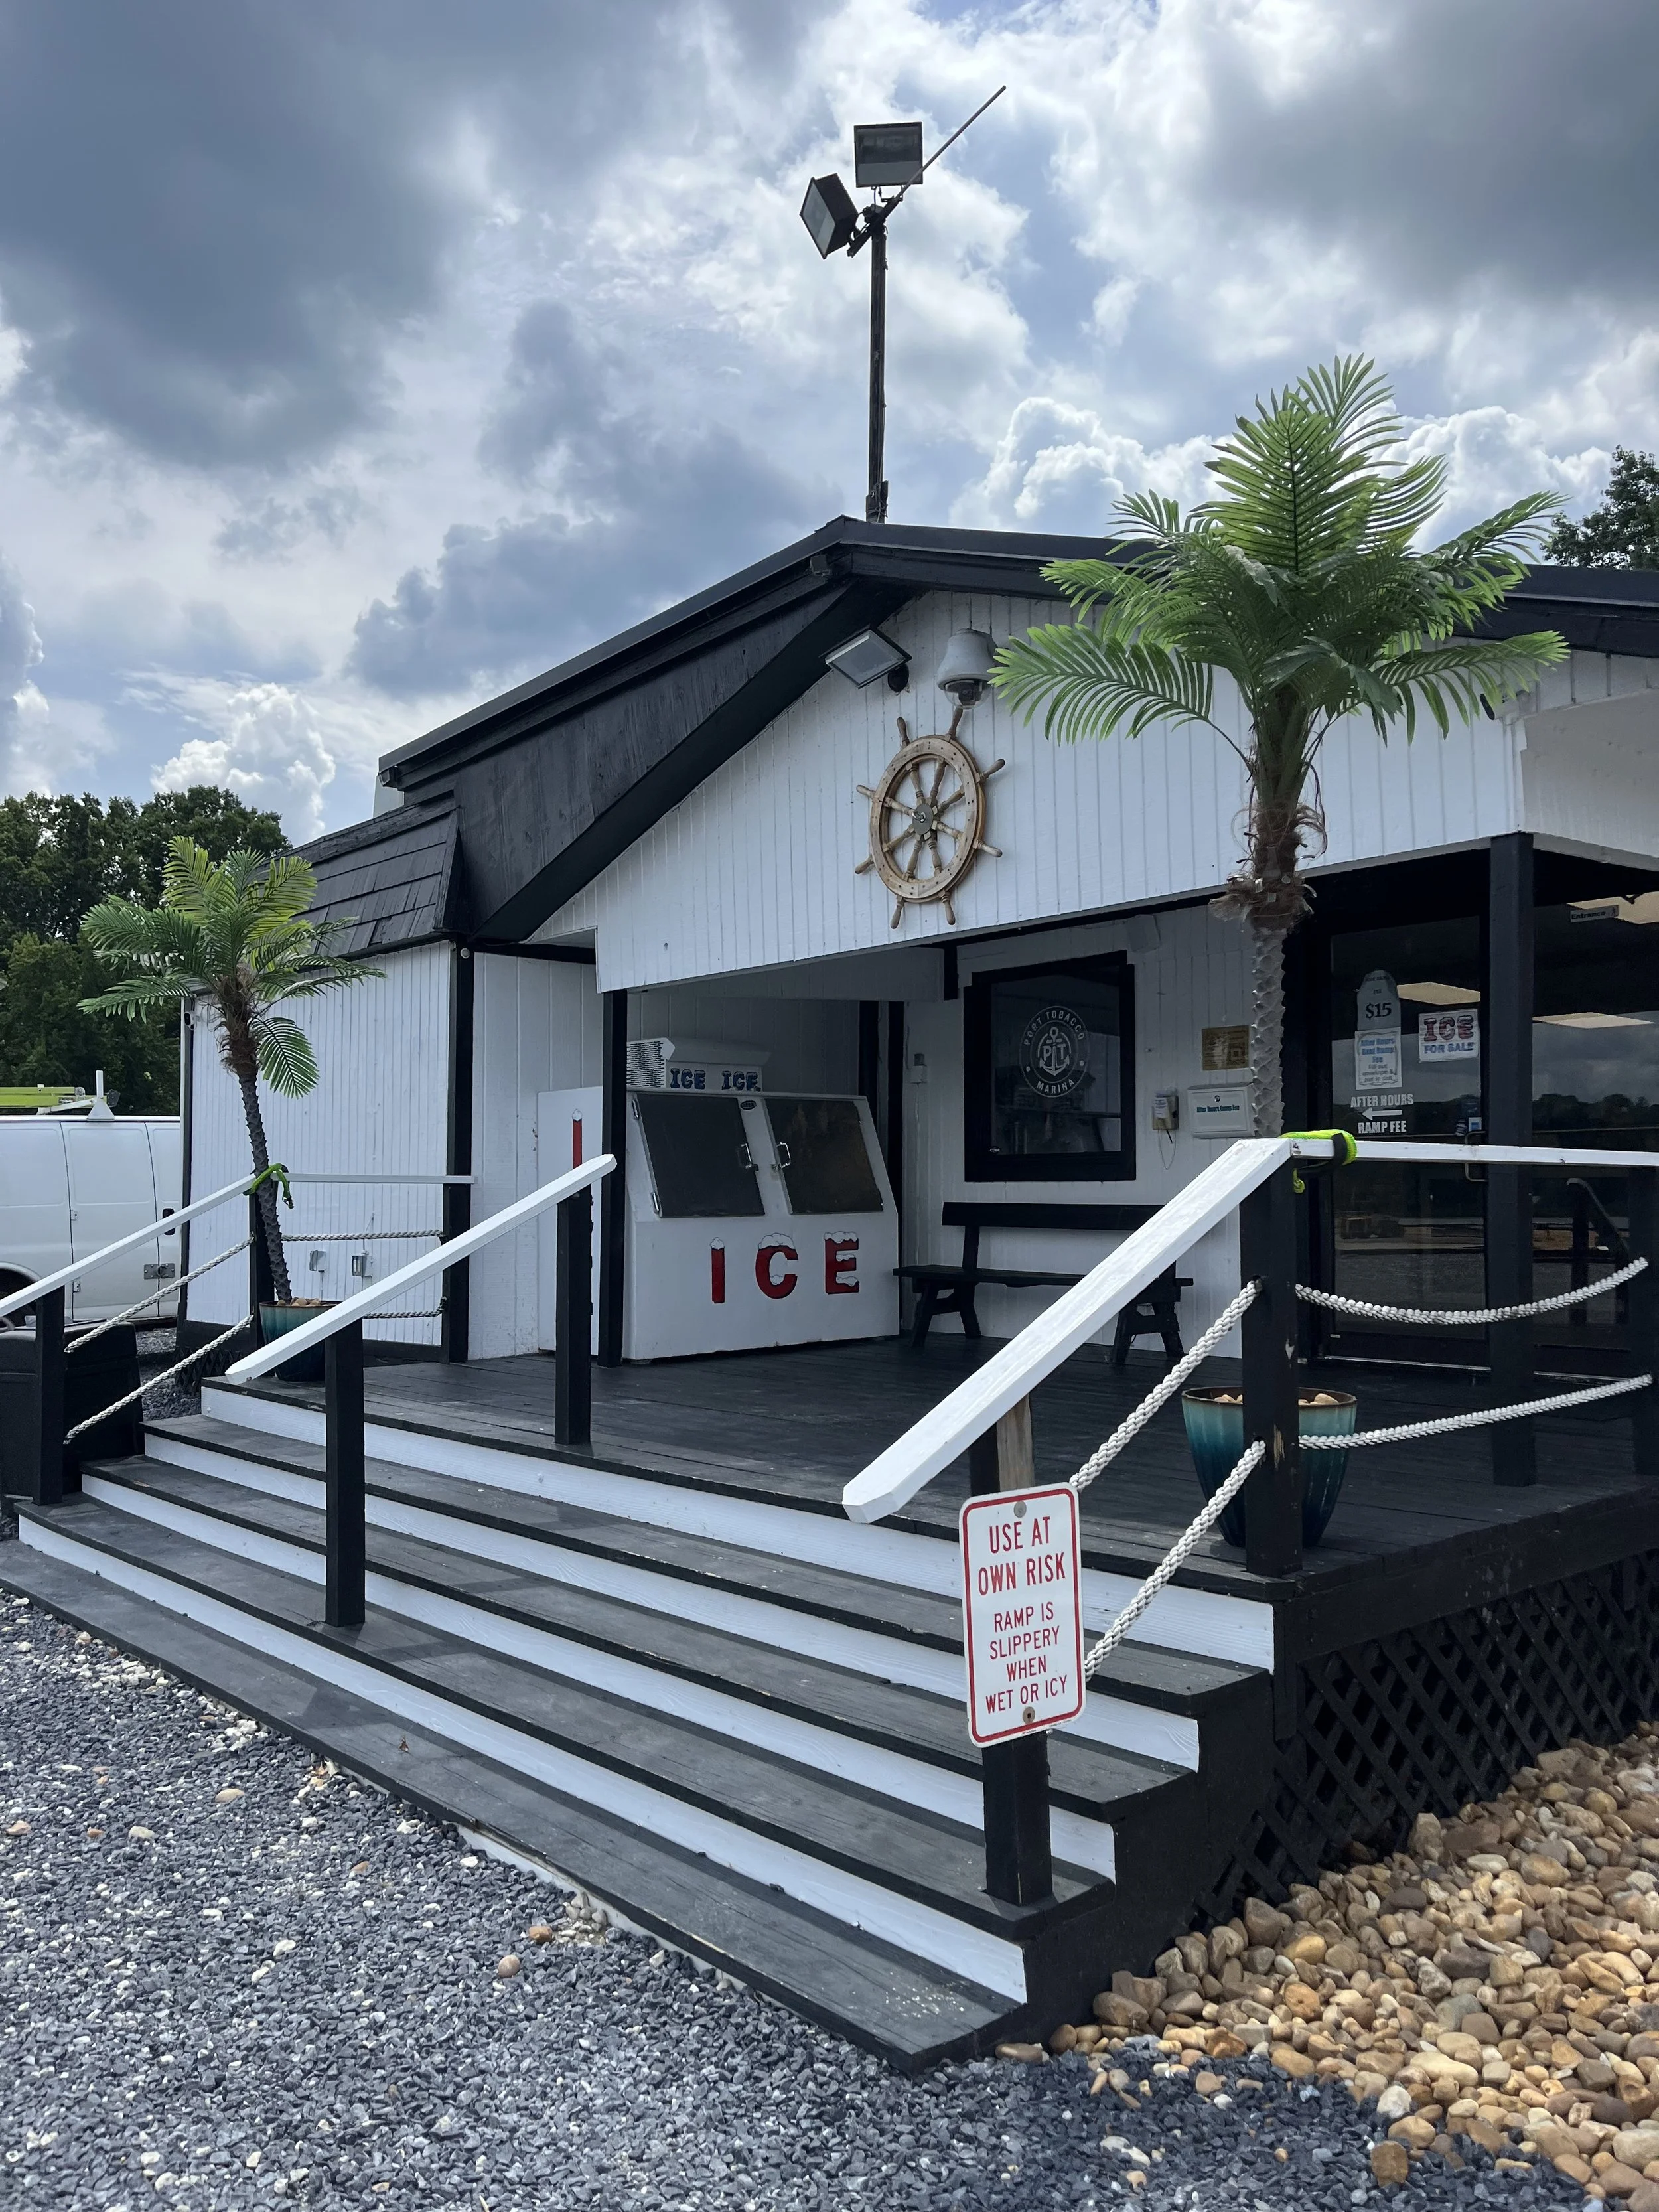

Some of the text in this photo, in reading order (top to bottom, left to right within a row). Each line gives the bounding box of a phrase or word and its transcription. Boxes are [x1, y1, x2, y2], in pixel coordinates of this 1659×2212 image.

[1571, 911, 1606, 920] Entrance
[1366, 1002, 1392, 1020] $15
[1023, 1010, 1085, 1045] PORT TOBACCO
[1423, 1015, 1474, 1042] ICE
[1424, 1042, 1475, 1054] FOR SALE
[670, 1068, 761, 1092] ICE ICE
[1037, 1078, 1074, 1094] MARINA
[1350, 1094, 1413, 1108] AFTER HOURS
[1358, 1120, 1407, 1134] RAMP FEE
[710, 1231, 859, 1304] ICE
[989, 1516, 1050, 1554] USE AT
[978, 1552, 1066, 1595] OWN RISK
[994, 1601, 1054, 1632] RAMP IS
[989, 1625, 1060, 1660] SLIPPERY
[1007, 1655, 1046, 1682] WHEN
[986, 1674, 1067, 1714] WET OR ICY
